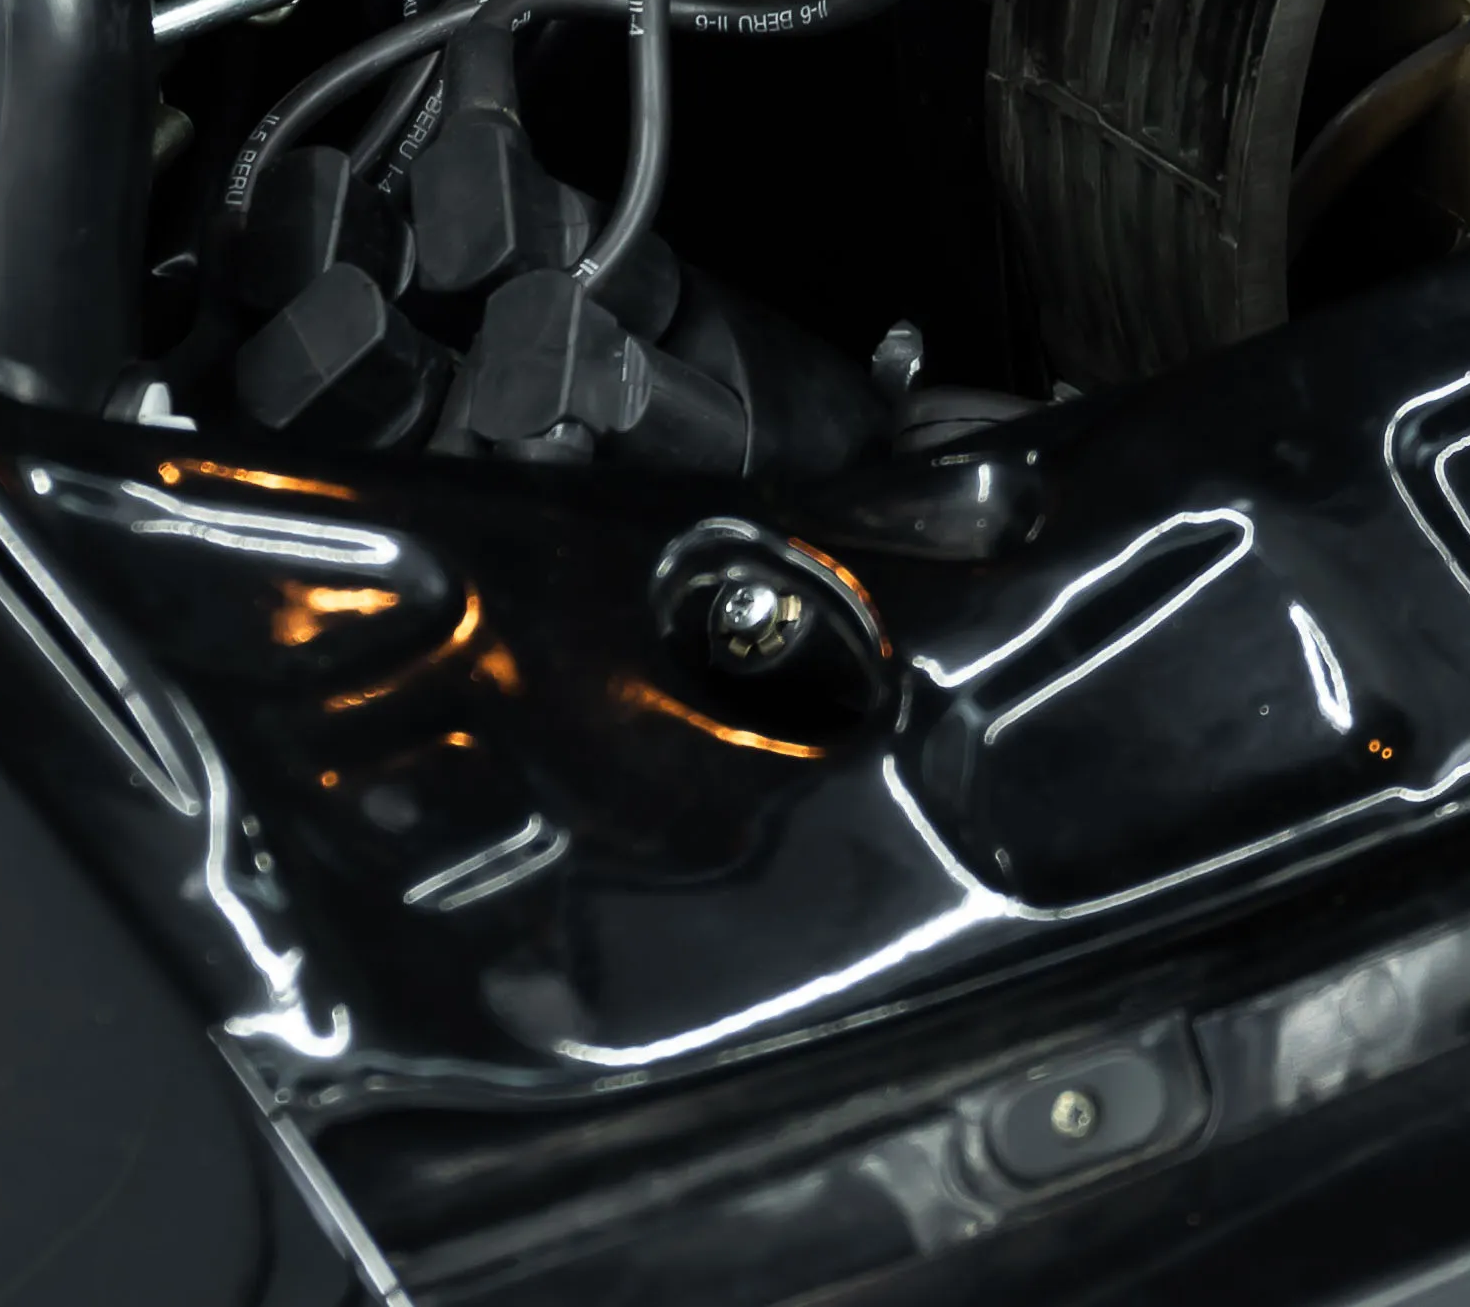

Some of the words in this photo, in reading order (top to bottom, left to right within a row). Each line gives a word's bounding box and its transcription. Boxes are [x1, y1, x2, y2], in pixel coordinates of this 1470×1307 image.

[627, 0, 646, 38] II-4
[694, 13, 729, 32] II-6
[737, 8, 795, 34] BERU
[398, 96, 444, 160] BERU
